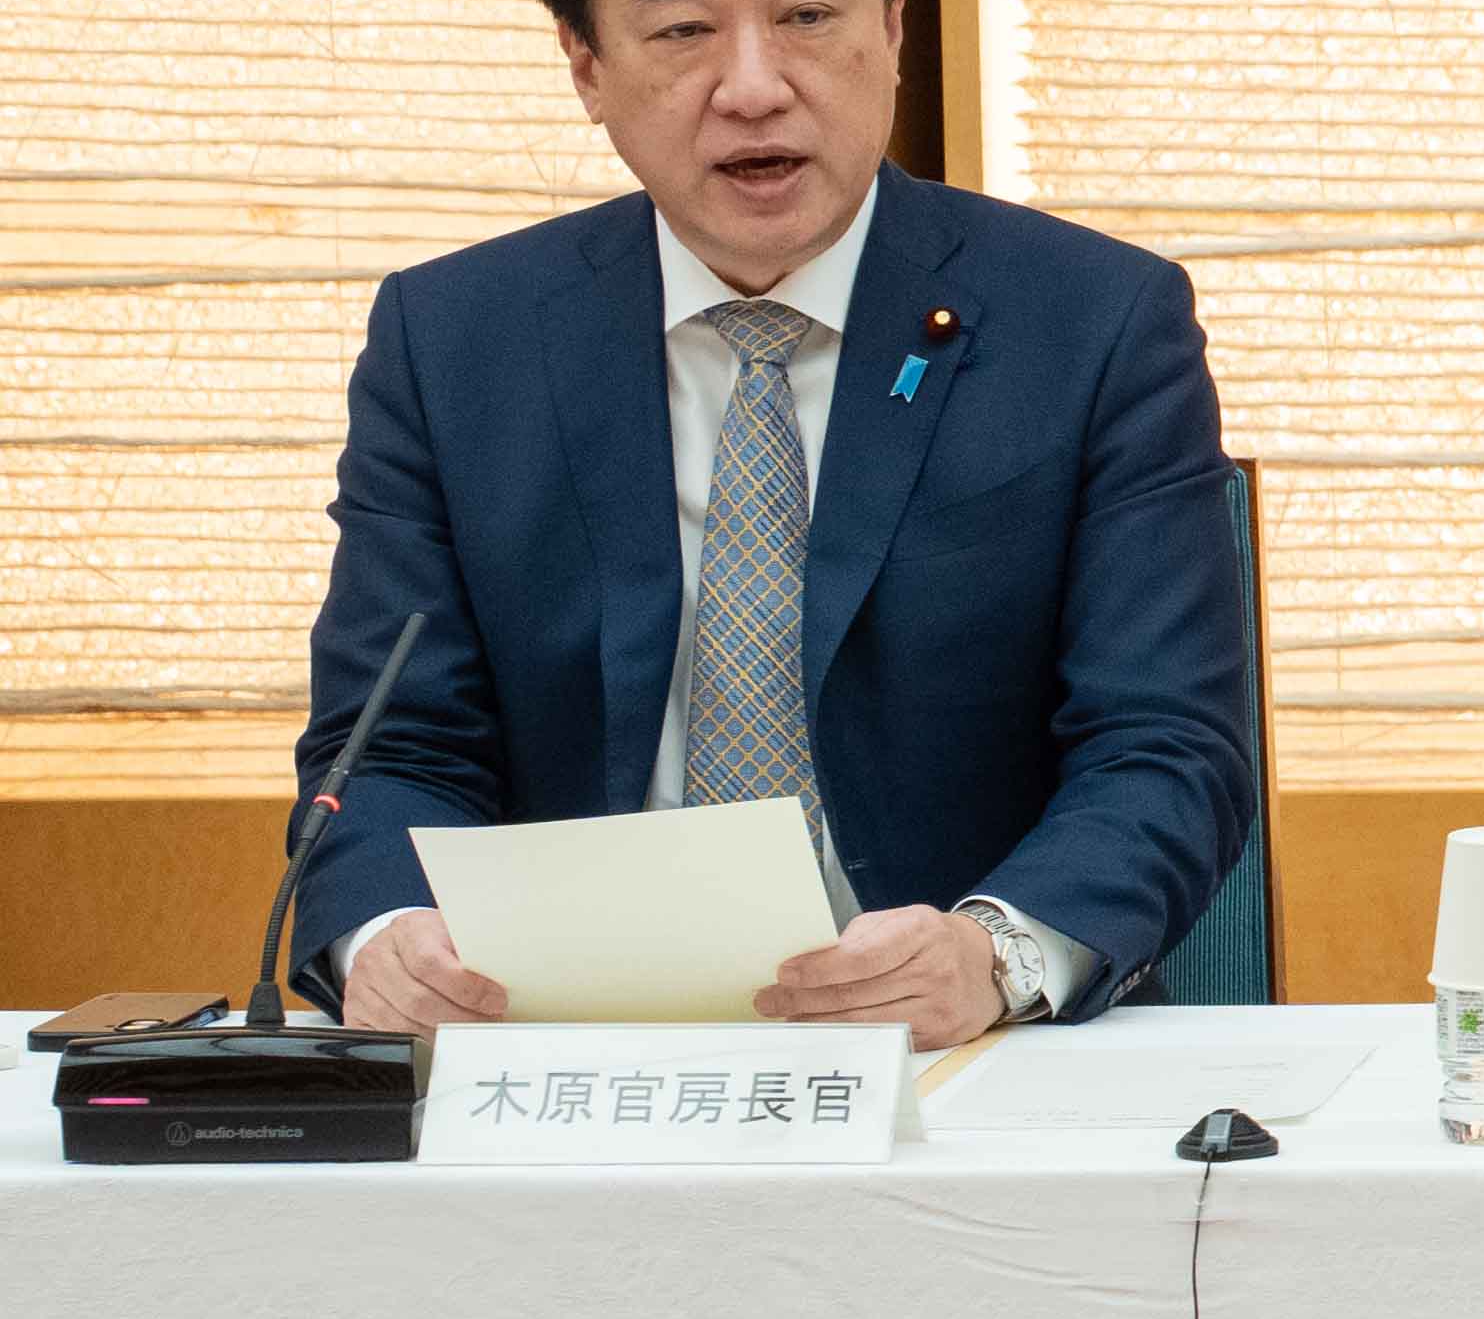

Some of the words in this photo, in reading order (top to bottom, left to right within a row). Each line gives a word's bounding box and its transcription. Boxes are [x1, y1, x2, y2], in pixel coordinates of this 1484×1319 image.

[470, 1070, 863, 1124] 木原官房長官
[194, 1126, 304, 1139] audio-technica
